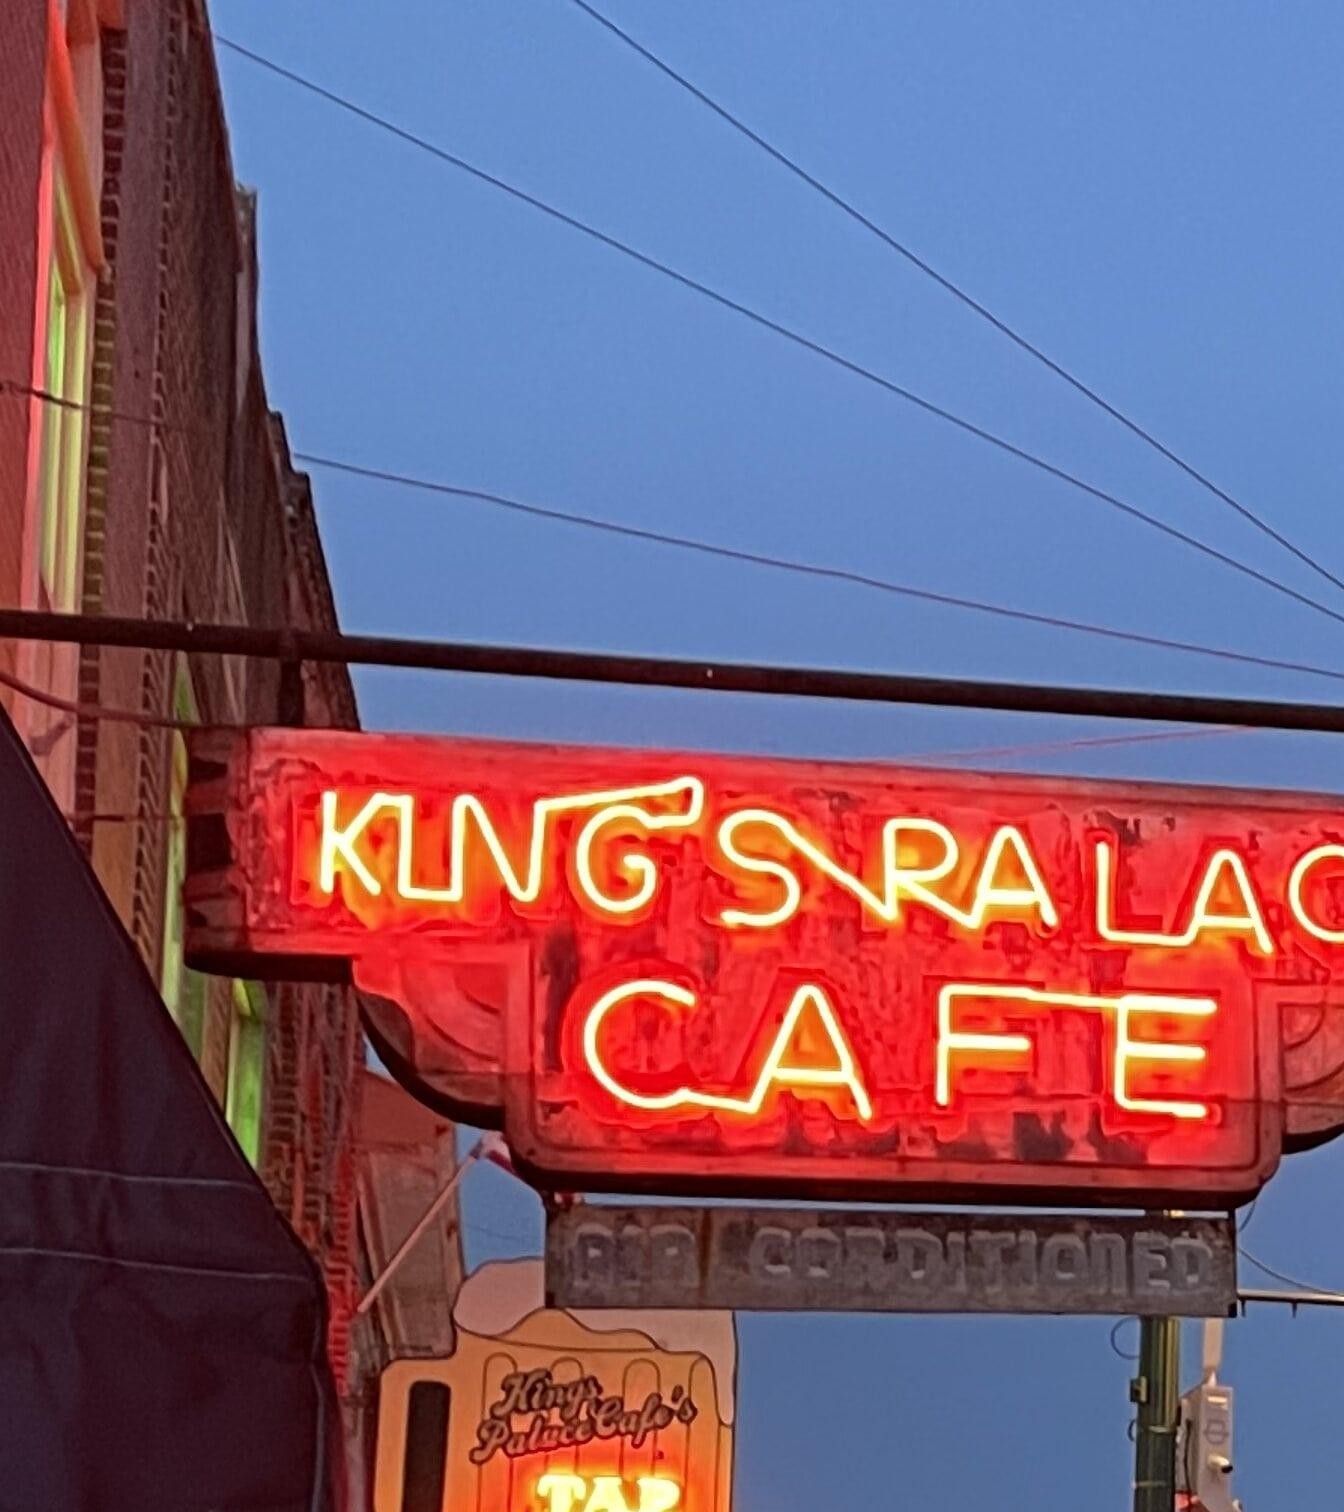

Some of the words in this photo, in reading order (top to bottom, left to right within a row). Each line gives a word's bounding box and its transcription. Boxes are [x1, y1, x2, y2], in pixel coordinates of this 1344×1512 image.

[583, 978, 1218, 1122] CAFE
[746, 1225, 1217, 1294] CONDITIONED
[469, 1411, 597, 1465] Palace
